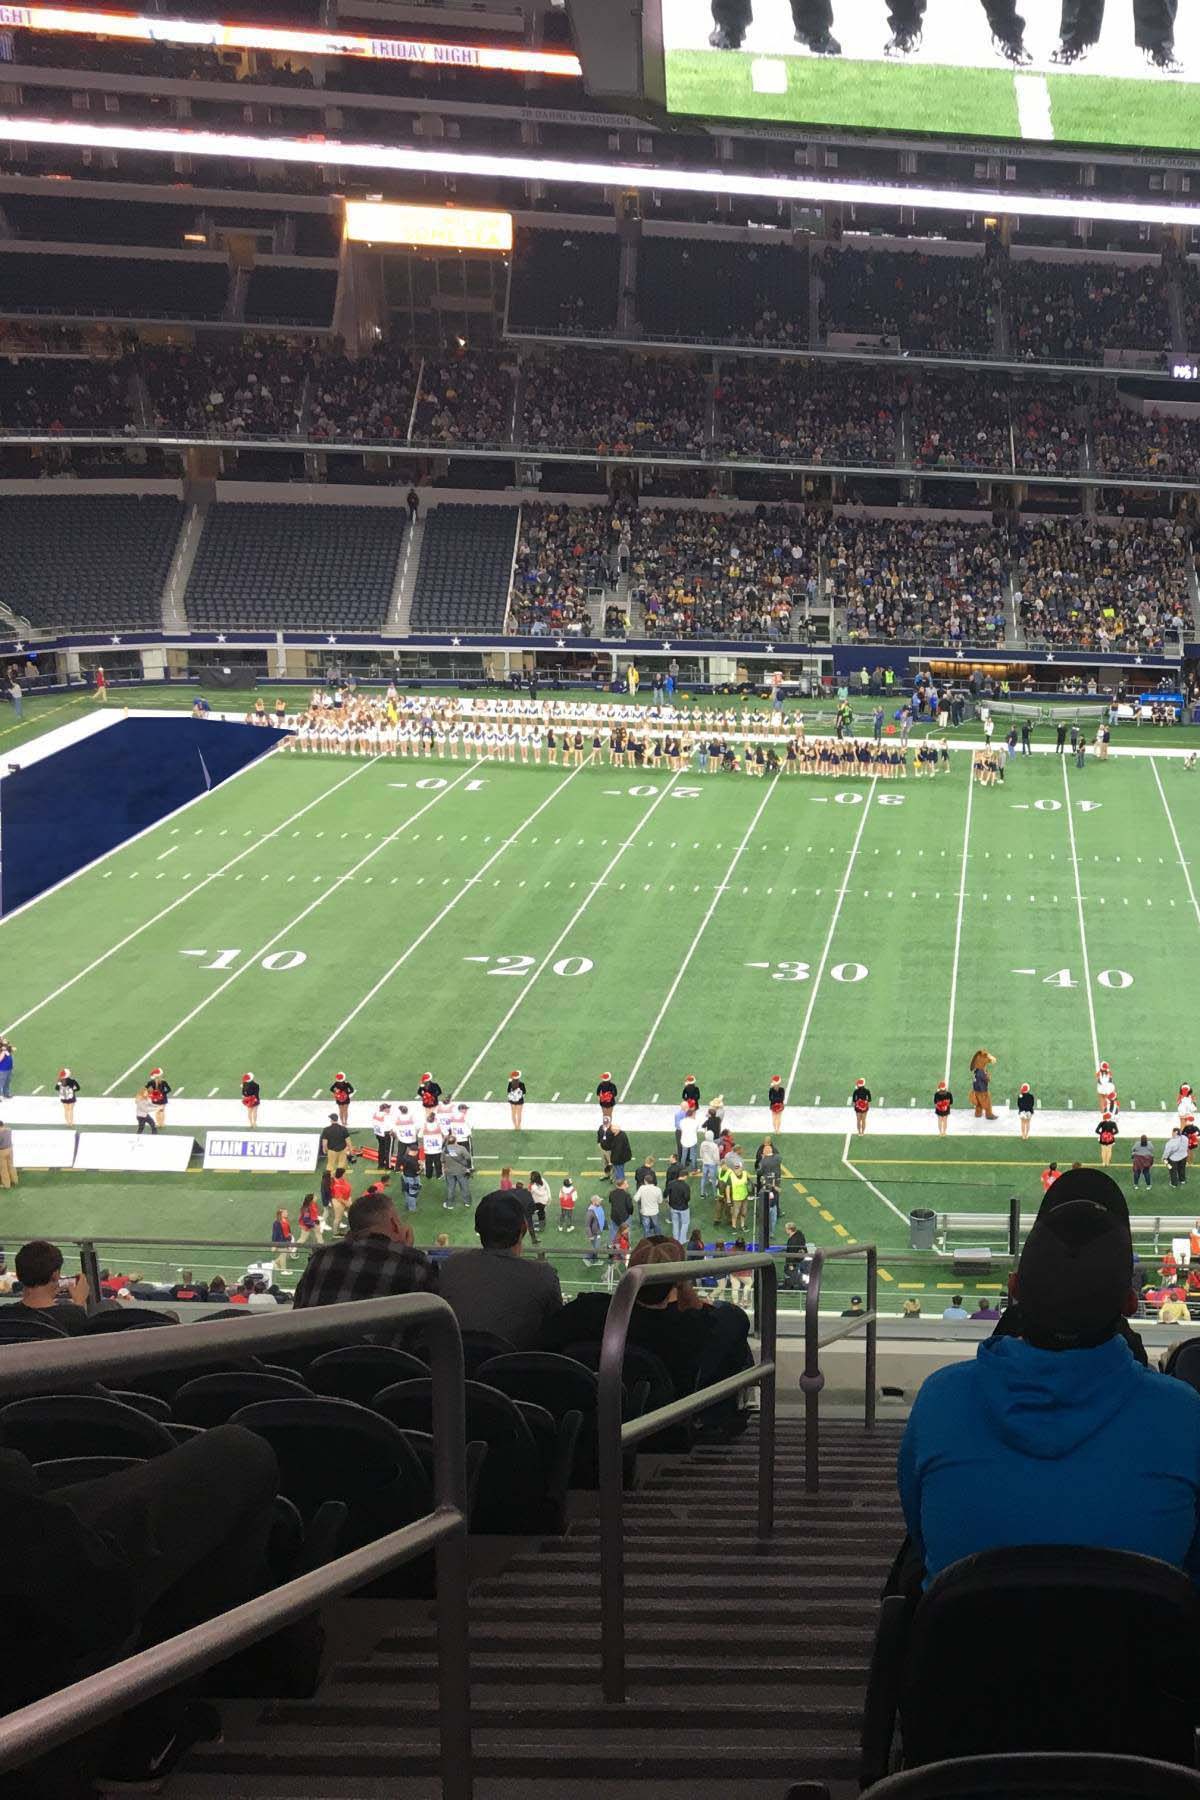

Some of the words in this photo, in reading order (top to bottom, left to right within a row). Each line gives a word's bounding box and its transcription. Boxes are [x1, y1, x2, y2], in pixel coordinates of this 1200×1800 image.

[371, 41, 428, 60] FRIDAY
[434, 48, 481, 64] NIGHT
[626, 785, 706, 799] 20
[833, 792, 907, 807] 30
[1033, 798, 1104, 812] 40
[197, 948, 308, 970] 10
[482, 954, 596, 977] 20
[770, 961, 870, 983] 30
[1040, 968, 1135, 990] 40
[210, 1141, 242, 1156] MAIN
[247, 1142, 286, 1157] EVENT
